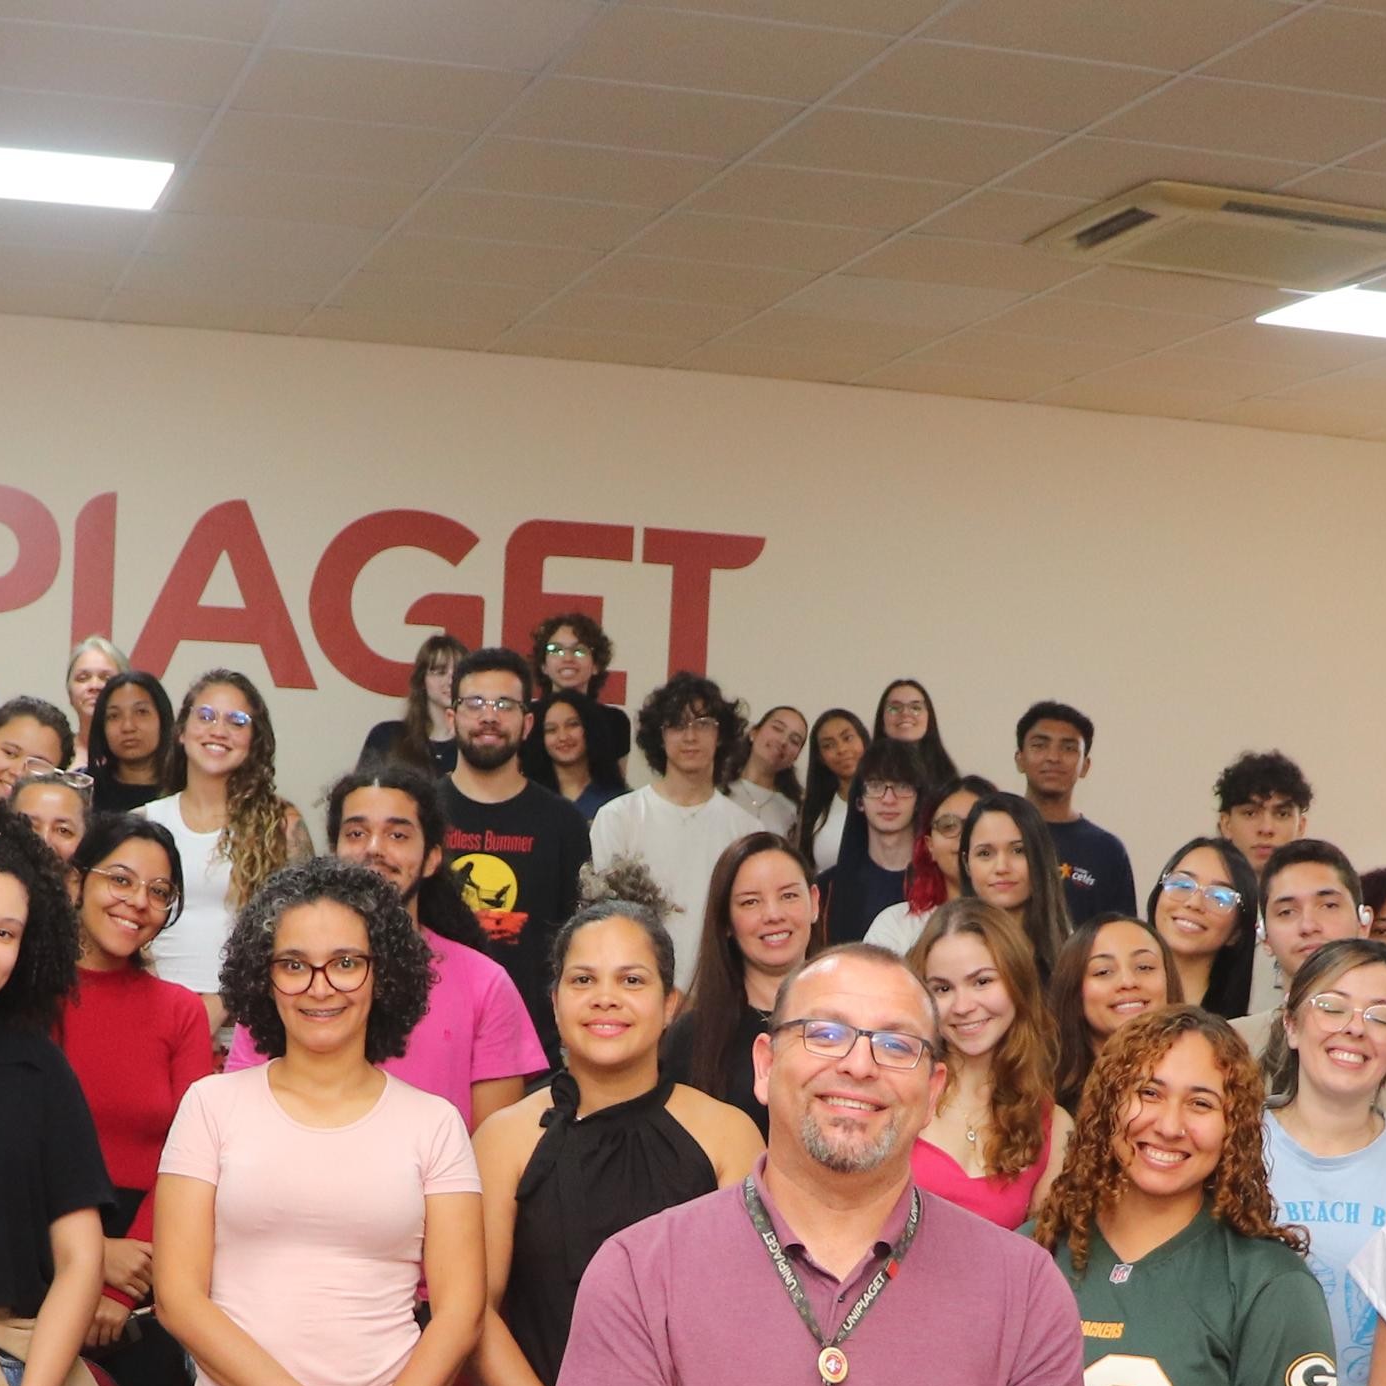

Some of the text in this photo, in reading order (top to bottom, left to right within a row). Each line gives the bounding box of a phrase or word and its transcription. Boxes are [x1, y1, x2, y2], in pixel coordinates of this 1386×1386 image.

[484, 829, 534, 852] Bummer
[1282, 1199, 1362, 1225] BEACH
[763, 1230, 798, 1292] UNIPIAGET
[842, 1271, 886, 1332] UNIPIAGET
[1080, 1320, 1126, 1339] ACKERS
